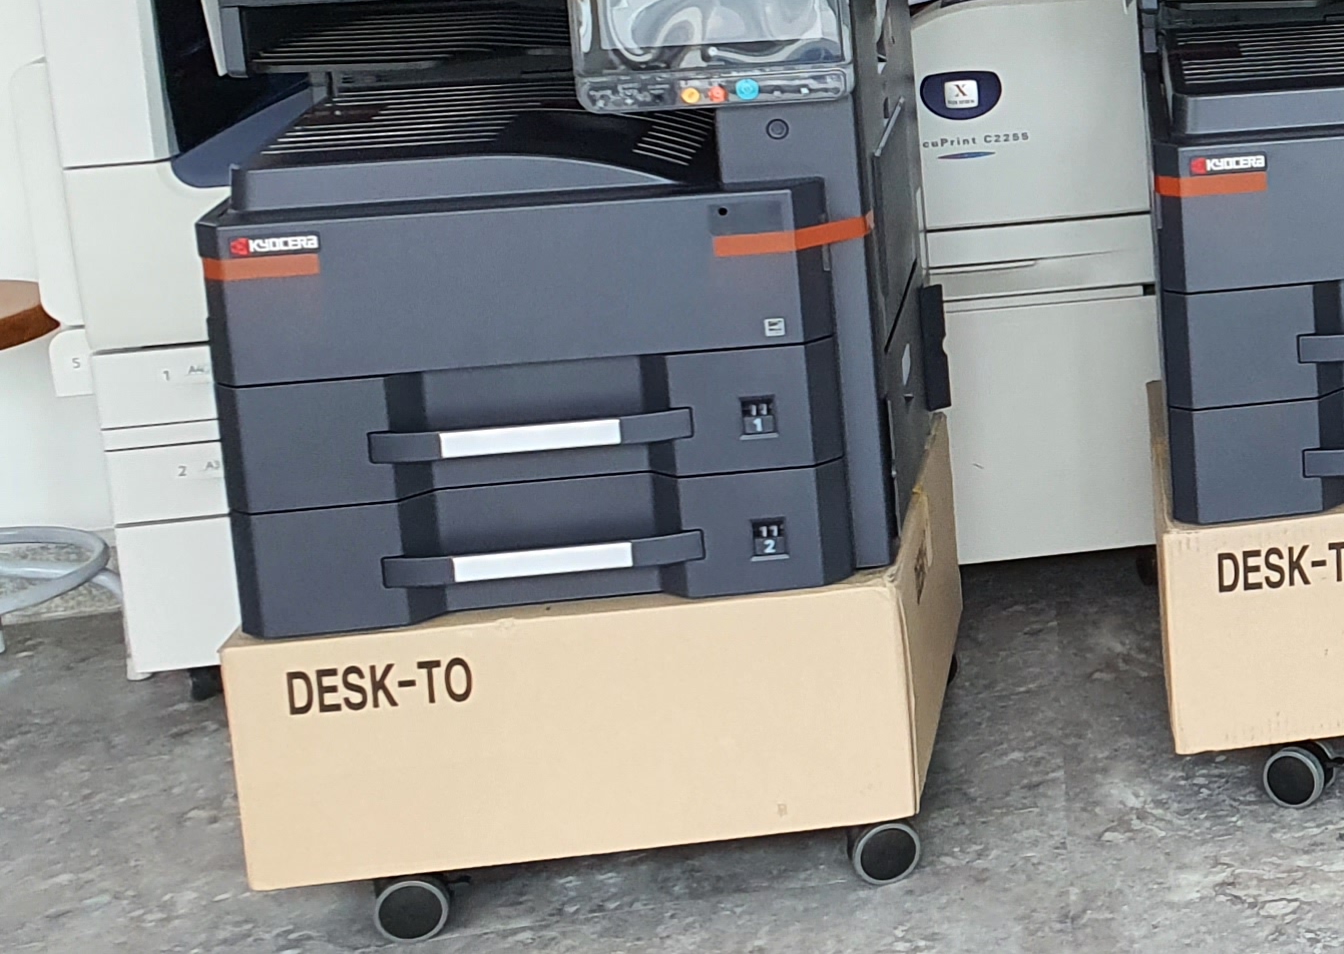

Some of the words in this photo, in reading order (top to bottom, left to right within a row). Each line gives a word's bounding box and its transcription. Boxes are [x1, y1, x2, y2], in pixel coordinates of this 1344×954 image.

[922, 137, 977, 148] cuPrint
[1205, 155, 1266, 171] KYOCERA
[248, 235, 319, 252] KYOCERA
[752, 418, 763, 432] 1
[763, 539, 777, 554] 2
[286, 657, 474, 716] DESK-TO
